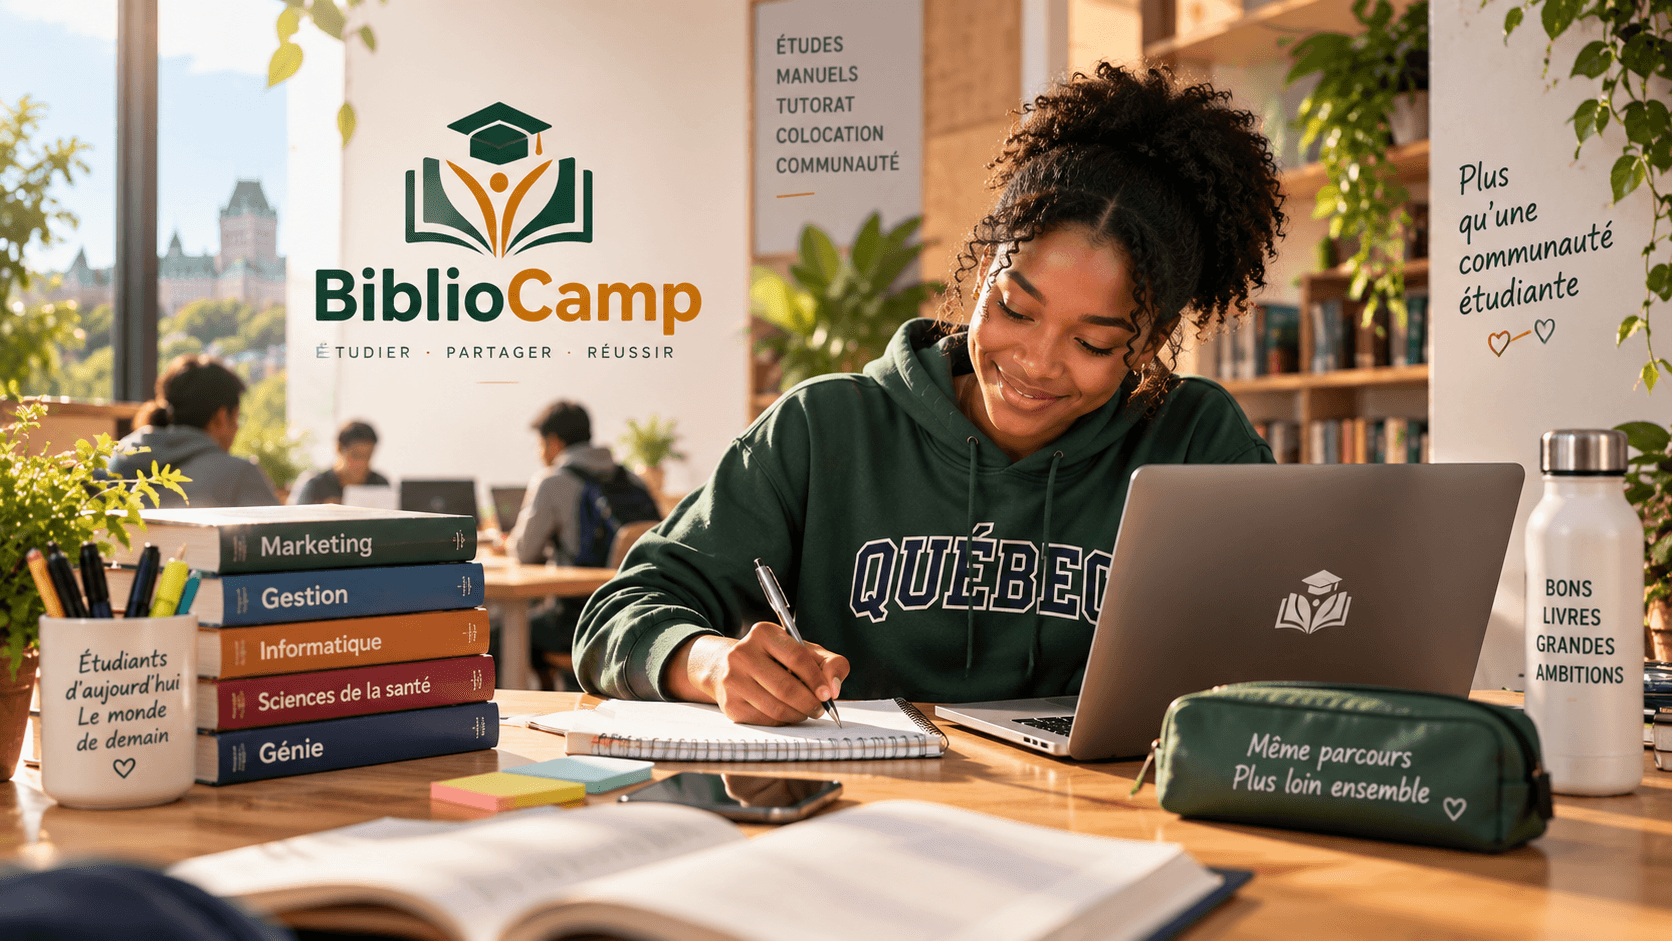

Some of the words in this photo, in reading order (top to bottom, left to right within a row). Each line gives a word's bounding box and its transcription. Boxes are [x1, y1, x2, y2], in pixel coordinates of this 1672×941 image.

[777, 34, 844, 55] ÉTUDES
[776, 65, 859, 85] MANUELS
[776, 96, 855, 114] TUTORAT
[776, 125, 884, 144] COLOCATION
[776, 151, 900, 174] COMMUNAUTÉ
[1459, 160, 1509, 195] Plus
[1459, 220, 1614, 275] communauté
[1459, 271, 1579, 315] étudiante
[260, 533, 373, 557] Marketing
[261, 585, 348, 609] Gestion
[1545, 578, 1592, 598] BONS
[1543, 606, 1601, 626] LIVRES
[260, 635, 382, 660] Informatique
[1536, 634, 1615, 656] GRANDES
[78, 648, 168, 674] Étudiants
[1535, 663, 1624, 684] AMBITIONS
[258, 689, 336, 711] Sciences
[339, 683, 362, 703] de
[366, 681, 381, 700] la
[385, 676, 431, 697] santé
[78, 706, 100, 726] Le
[107, 699, 167, 723] monde
[76, 732, 98, 752] de
[105, 727, 169, 749] demain
[259, 737, 324, 764] Génie
[1246, 732, 1310, 761] Même
[1316, 745, 1412, 771] parcours
[1232, 764, 1277, 793] Plus
[1284, 767, 1322, 796] loin
[1330, 775, 1430, 804] ensemble
